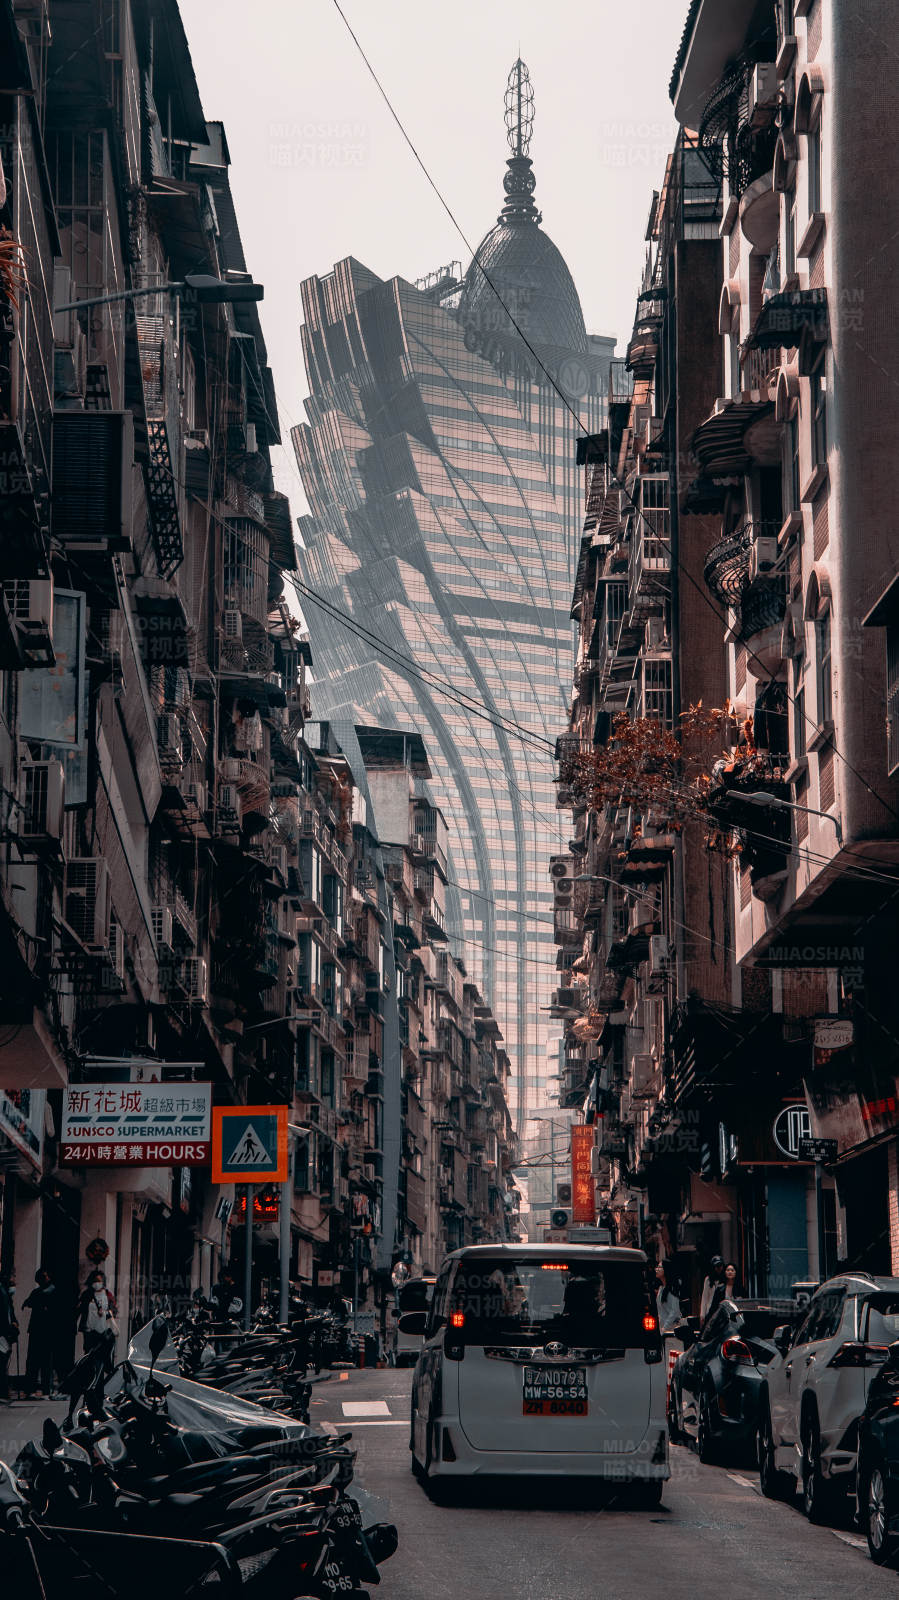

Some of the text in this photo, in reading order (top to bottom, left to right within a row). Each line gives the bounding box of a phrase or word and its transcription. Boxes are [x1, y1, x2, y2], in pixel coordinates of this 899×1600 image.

[67, 1126, 205, 1137] SUNSCO SUPERMARKET
[524, 1386, 586, 1399] MW-56-54
